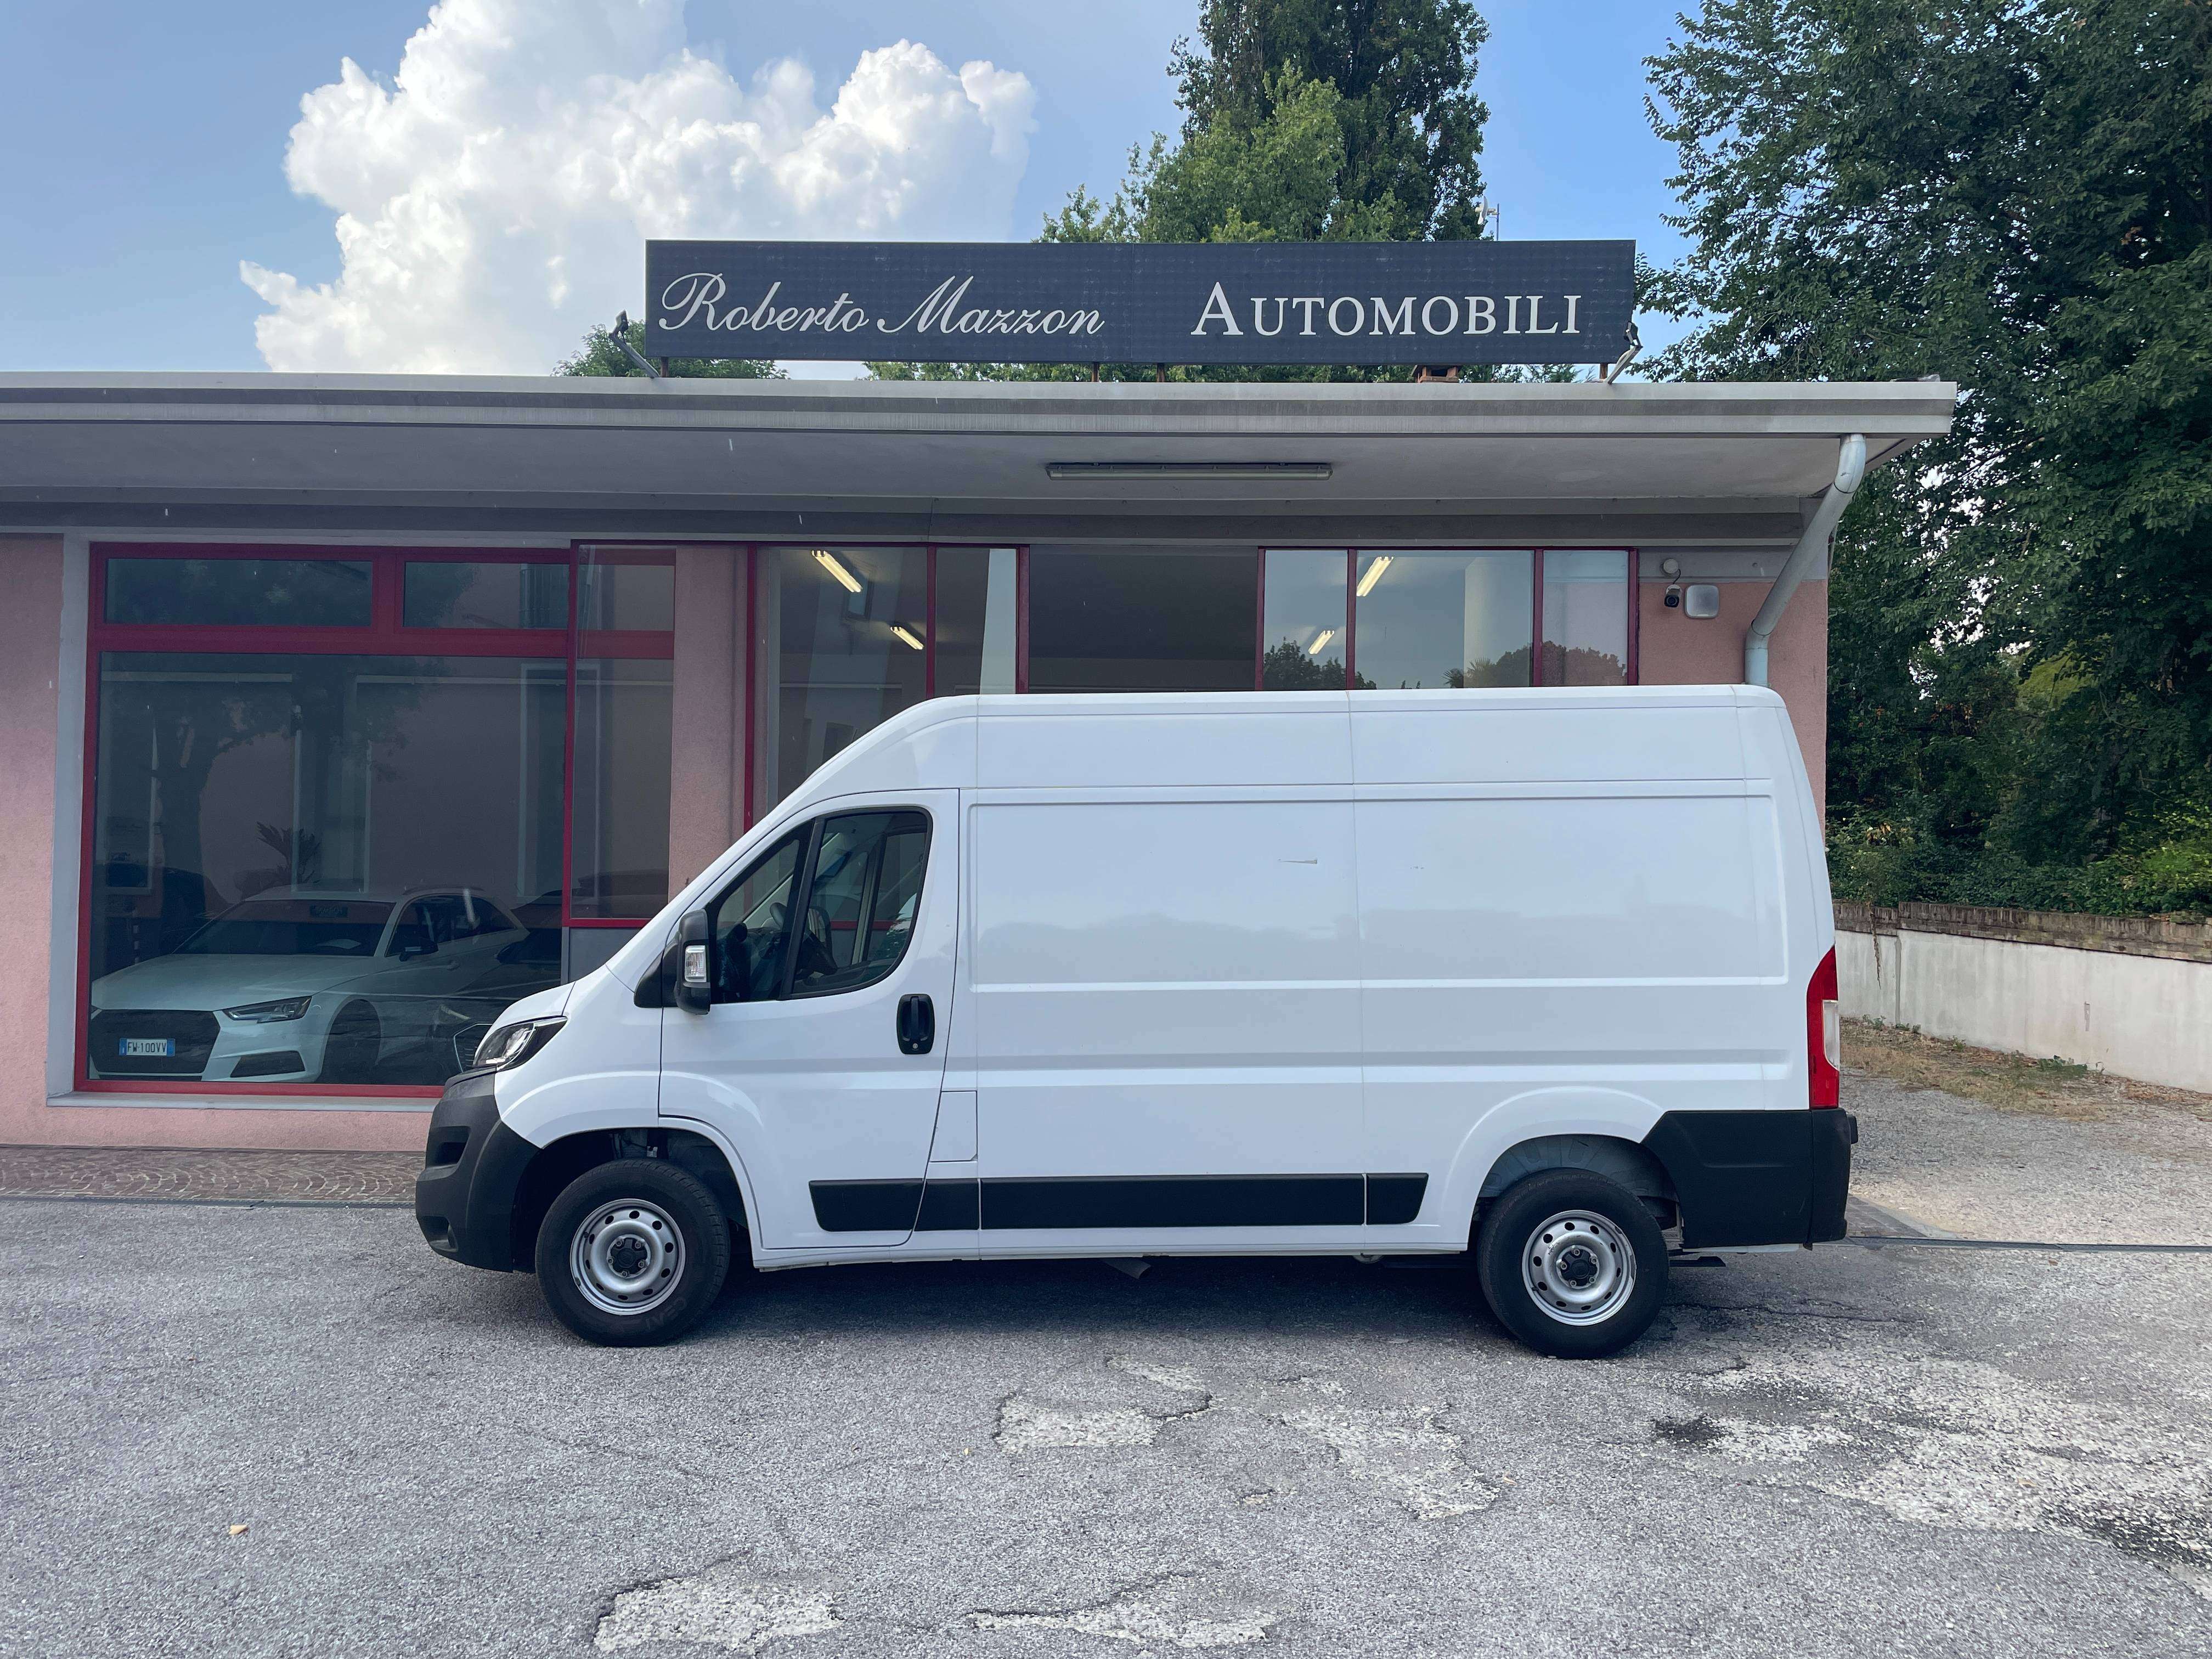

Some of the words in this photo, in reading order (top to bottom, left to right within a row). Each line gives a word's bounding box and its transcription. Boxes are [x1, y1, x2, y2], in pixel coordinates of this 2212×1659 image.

[658, 273, 870, 332] Roberto
[877, 275, 1105, 335] Mazzon
[1190, 281, 1582, 336] AUTOMOBILI
